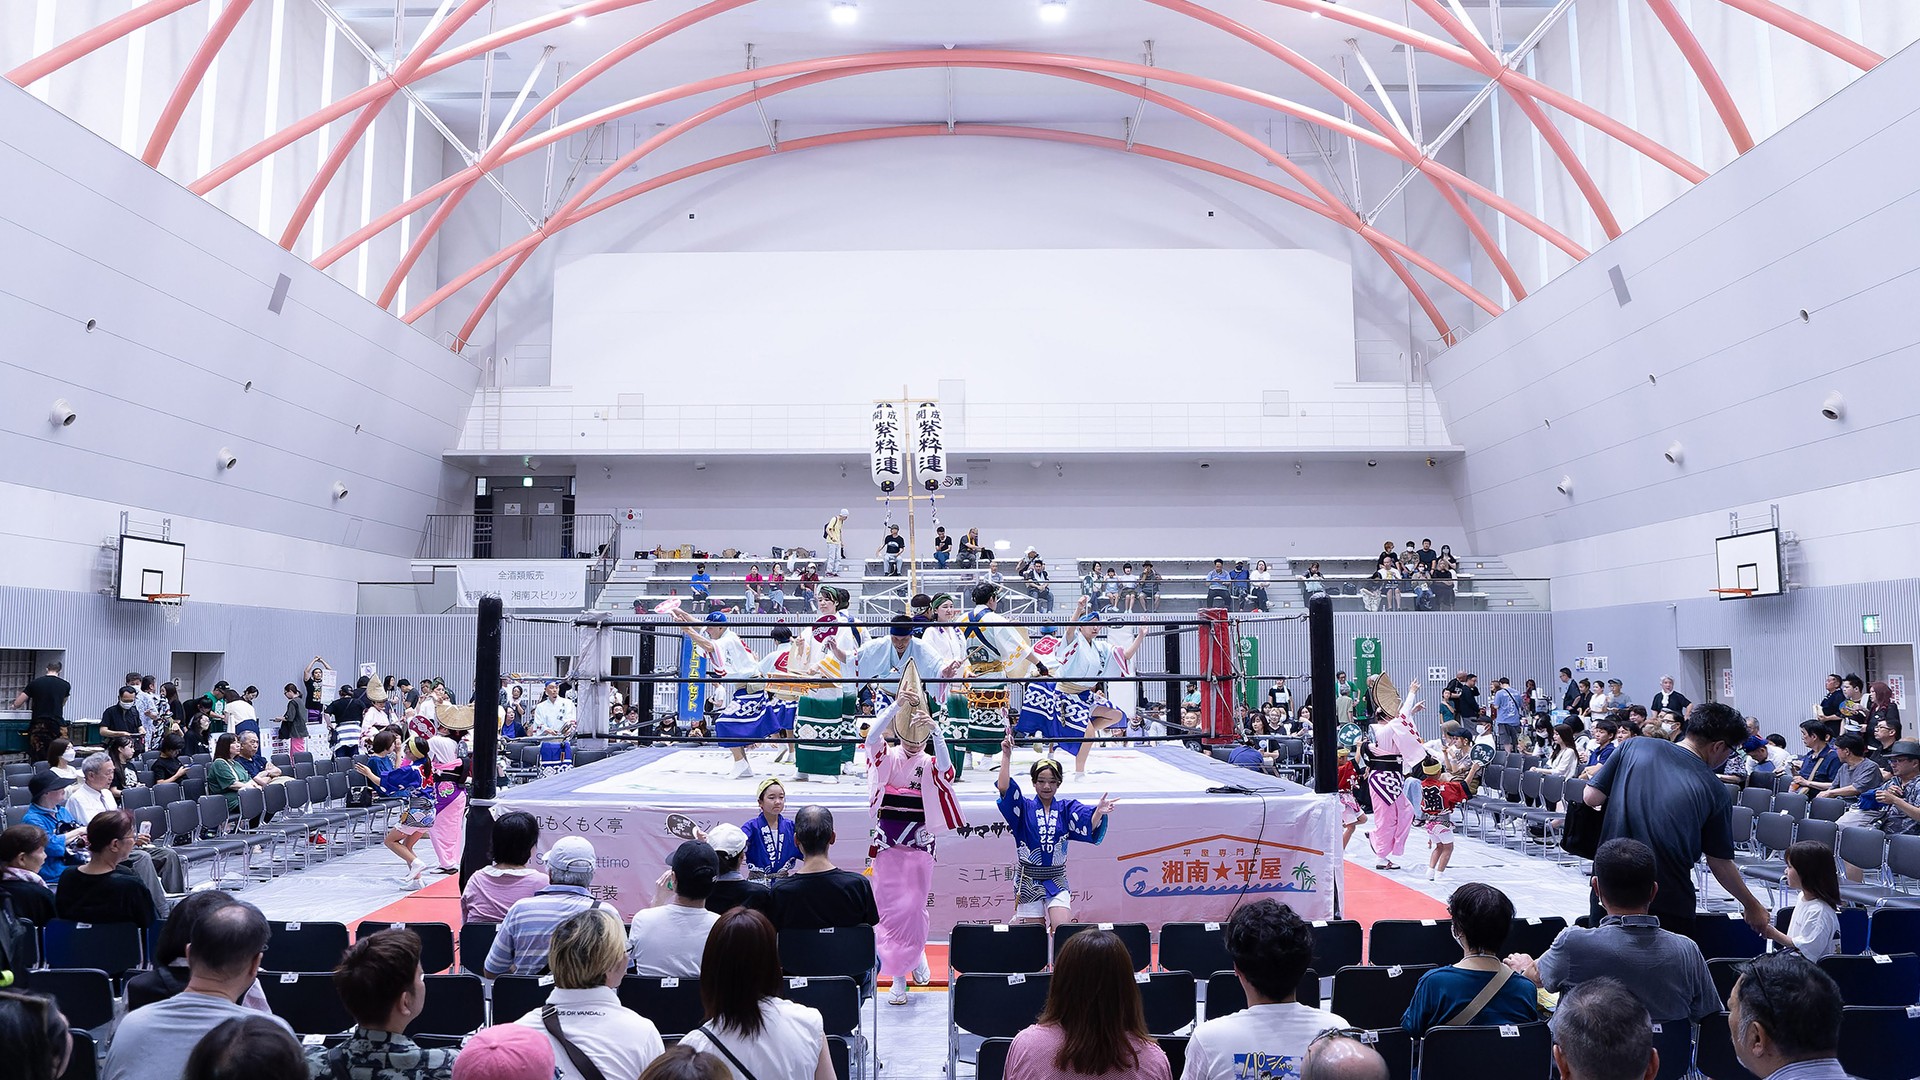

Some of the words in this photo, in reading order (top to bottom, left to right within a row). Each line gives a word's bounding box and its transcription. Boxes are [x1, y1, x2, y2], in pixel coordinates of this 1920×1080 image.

[498, 570, 545, 580] 全酒類販売
[958, 867, 1017, 882] ミユキ動
